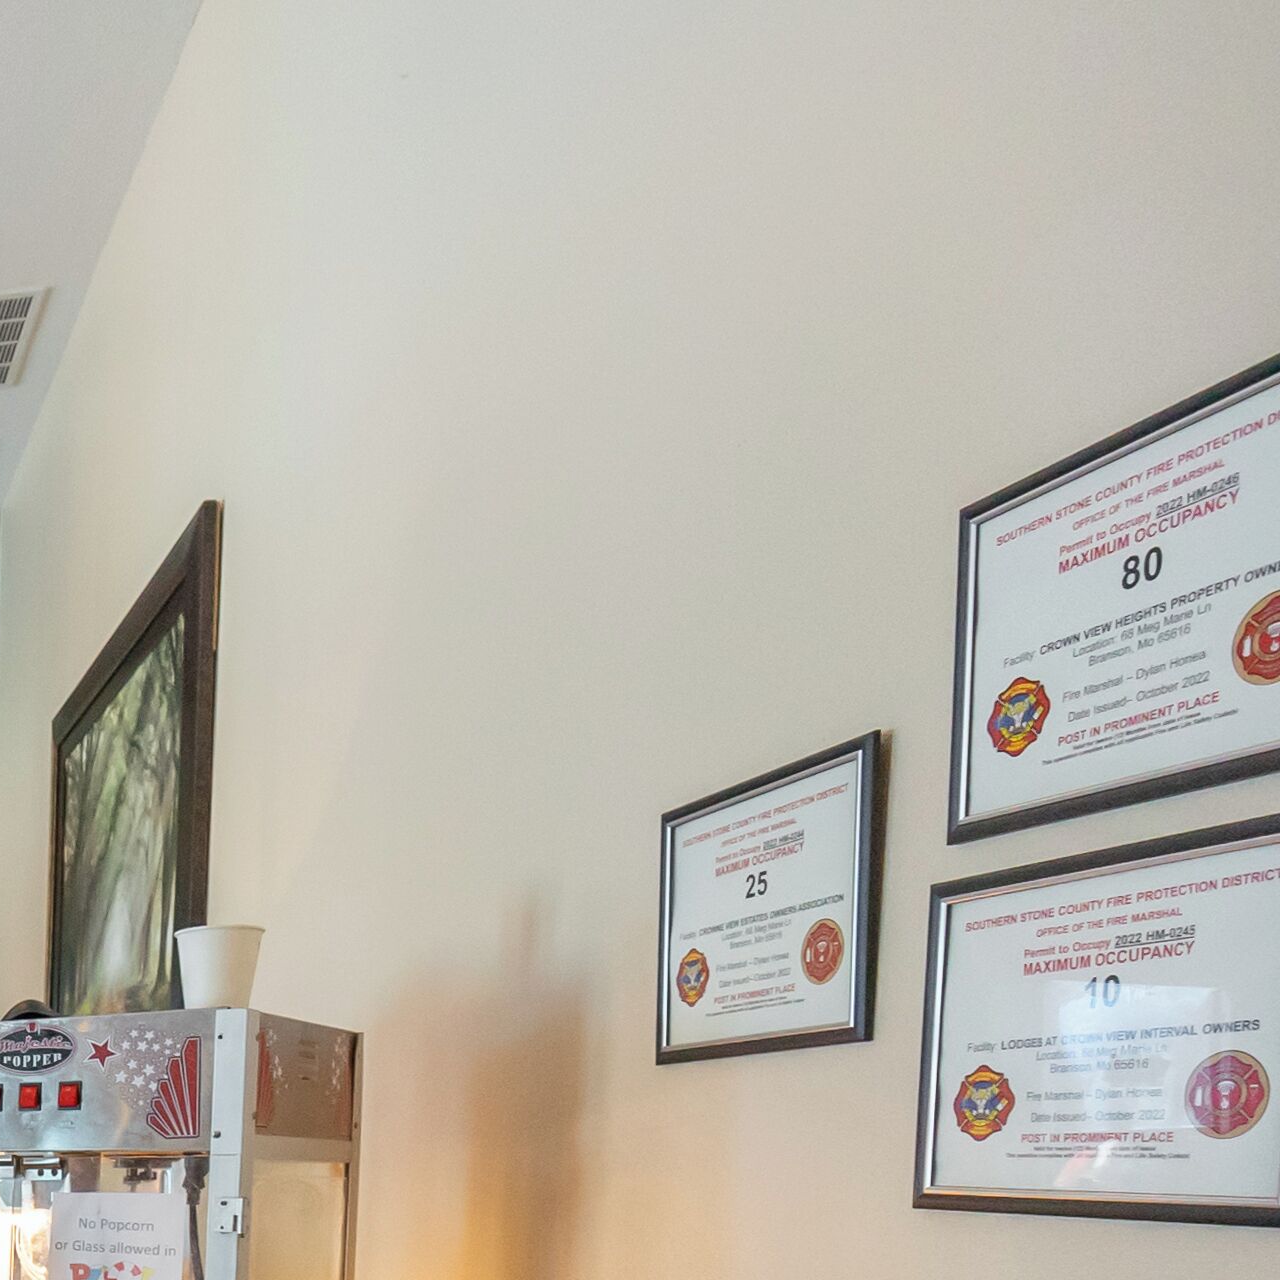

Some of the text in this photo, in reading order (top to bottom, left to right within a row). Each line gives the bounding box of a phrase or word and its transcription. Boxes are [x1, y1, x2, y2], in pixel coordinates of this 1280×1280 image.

[996, 513, 1052, 546] SOUTHERN
[1055, 496, 1092, 520] STONE
[1095, 473, 1143, 502] COUNTY
[1146, 458, 1174, 479] FIRE
[1178, 418, 1263, 465] PROTECTION
[1072, 460, 1225, 531] OFFICE OF THE FIRE MARSHAL
[1059, 488, 1240, 574] MAXIMUM OCCUPANCY
[1060, 535, 1092, 556] Permit
[1096, 531, 1106, 541] to
[1110, 512, 1151, 535] Occupy
[1156, 496, 1183, 516] 2022
[1122, 546, 1162, 590] 80
[1040, 632, 1081, 655] CROWN
[1083, 621, 1112, 639] VIEW
[1115, 602, 1166, 629] HEIGHTS
[1171, 575, 1240, 610] PROPERTY
[1197, 603, 1212, 615] Ln
[1137, 637, 1154, 650] Mo
[1063, 690, 1081, 702] Fire
[1084, 675, 1123, 696] Marshal
[1068, 708, 1090, 722] Date
[1136, 681, 1179, 701] October
[1182, 670, 1210, 688] 2022
[1058, 730, 1087, 746] POST
[1090, 725, 1100, 737] IN
[1104, 704, 1175, 733] PROMINENT
[1177, 691, 1220, 713] PLACE
[752, 840, 804, 865] OCCUPANCY
[746, 871, 767, 899] 25
[965, 914, 1018, 932] SOUTHERN
[1020, 908, 1055, 922] STONE
[1058, 899, 1105, 916] COUNTY
[1106, 894, 1132, 908] FIRE
[1137, 880, 1218, 902] PROTECTION
[1036, 907, 1183, 937] OFFICE OF THE FIRE MARSHAL
[1024, 946, 1055, 958] Permit
[1059, 944, 1069, 953] to
[1073, 939, 1111, 952] Occupy
[1115, 933, 1142, 946] 2022
[1024, 941, 1195, 976] MAXIMUM OCCUPANCY
[1085, 975, 1120, 1008] 10
[1001, 1037, 1043, 1050] LODGES
[1044, 1036, 1058, 1047] AT
[1106, 1030, 1140, 1042] VIEW
[1140, 1025, 1198, 1040] INTERVAL
[1202, 1020, 1260, 1035] OWNERS
[3, 1052, 62, 1068] POPPER
[1114, 1058, 1149, 1070] 65616
[1021, 1131, 1174, 1143] POST IN PROMINENT PLACE
[78, 1217, 154, 1233] No Popcorn
[55, 1240, 177, 1257] or Glass allowed in
